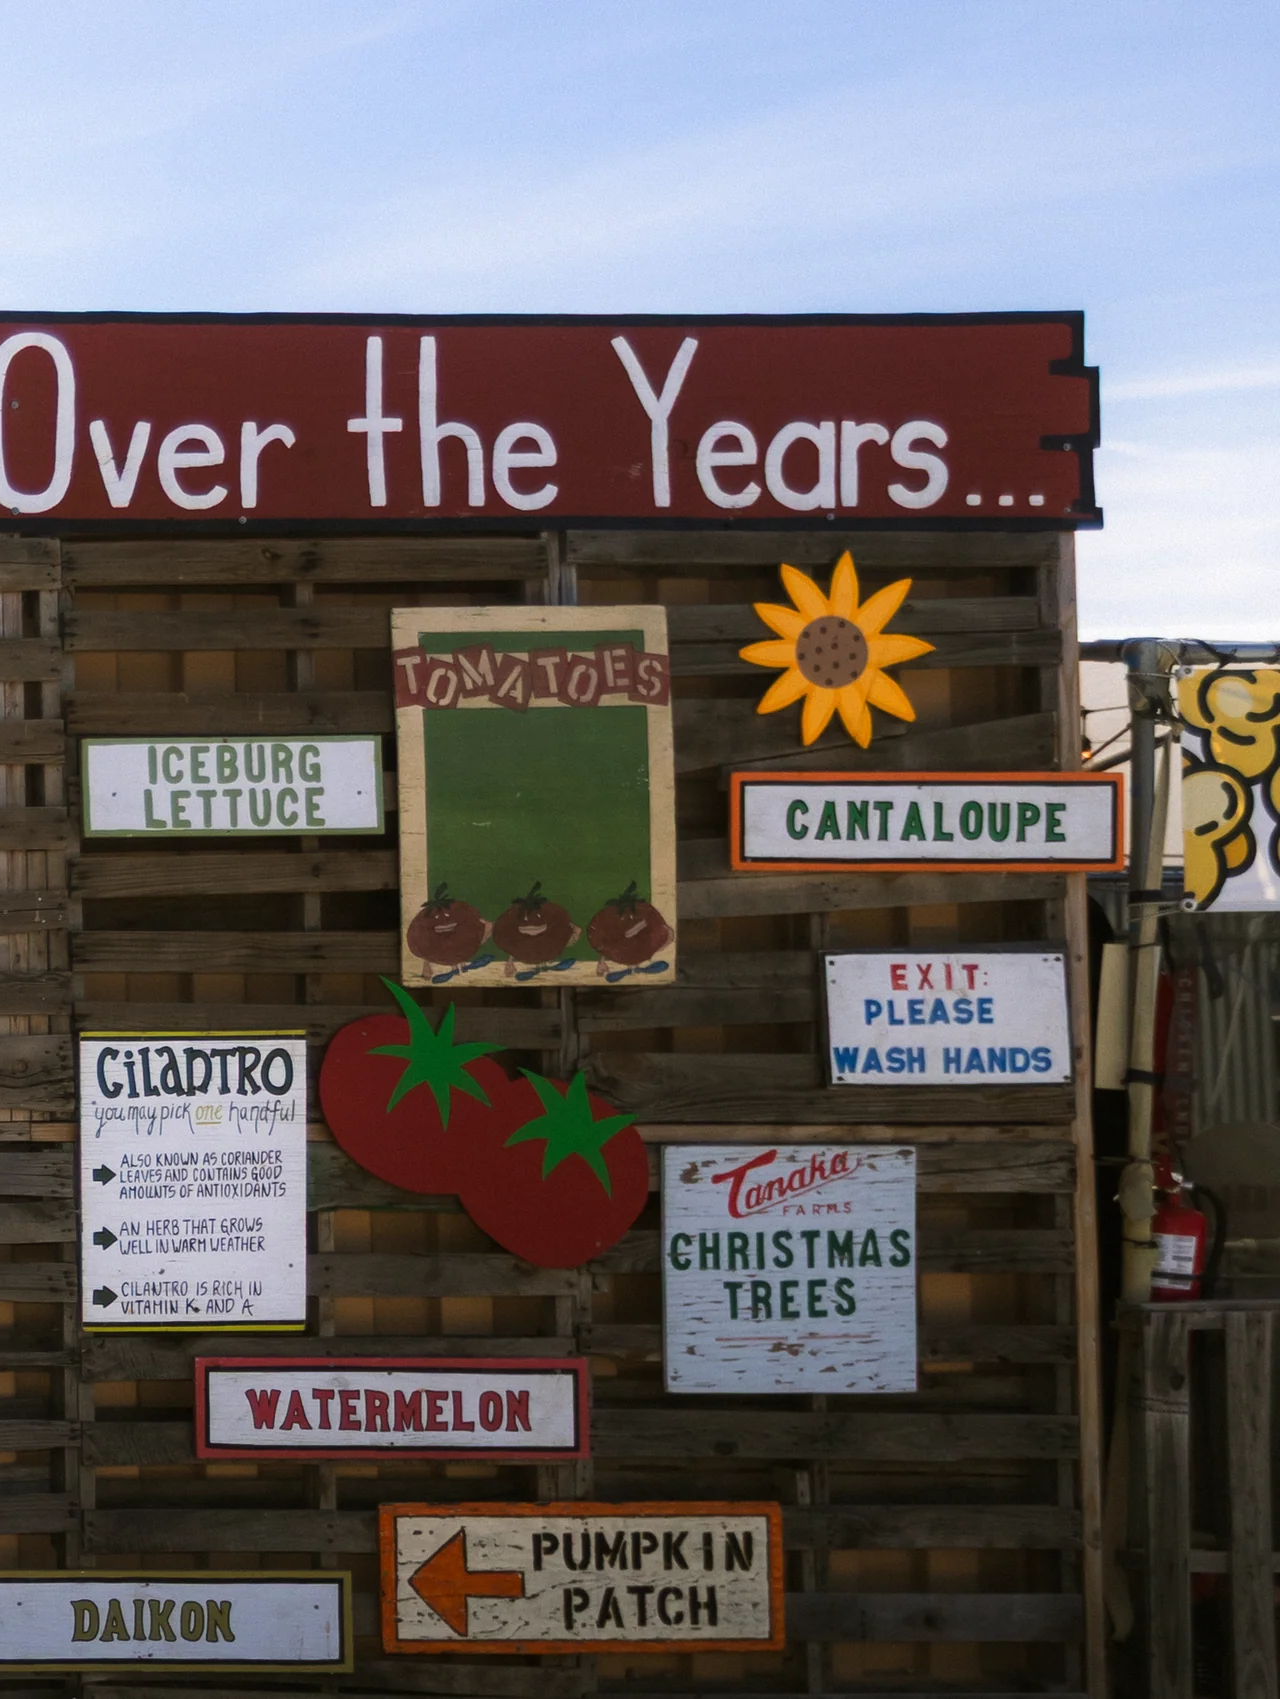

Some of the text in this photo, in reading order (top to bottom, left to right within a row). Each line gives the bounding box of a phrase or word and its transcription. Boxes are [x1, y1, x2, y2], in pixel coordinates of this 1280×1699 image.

[347, 335, 558, 511] the
[611, 336, 1044, 510] Years...
[397, 649, 663, 706] TOMATOES
[148, 743, 322, 785] ICEBURG
[143, 786, 325, 829] LETTUCE
[786, 799, 1066, 842] CANTALOUPE
[890, 963, 988, 991] EXIT:
[864, 998, 994, 1025] PLEASE
[834, 1047, 1052, 1074] WASH HANDS
[95, 1099, 295, 1138] you may pick one handful
[120, 1150, 283, 1167] ALSO KNOWN AS CORIANDER
[120, 1165, 283, 1183] LEAVES AND CONTAINS GOOD
[120, 1182, 286, 1199] AMOUNTS OF ANTIOXIDANTS
[711, 1149, 862, 1219] Tanaka
[120, 1217, 263, 1236] AN HERB THAT GROWS
[783, 1202, 852, 1216] FARMS
[119, 1236, 265, 1255] WELL IN WARM WEATHER
[669, 1228, 911, 1271] CHRISTMAS
[121, 1280, 262, 1298] CILANTRO IS RICH IN
[121, 1300, 178, 1315] VITAMIN
[206, 1299, 235, 1314] AND
[242, 1299, 254, 1316] A
[723, 1277, 856, 1320] TREES
[245, 1388, 532, 1433] WATERMELON
[532, 1530, 754, 1571] PUMPKIN
[71, 1599, 235, 1642] DAIKON
[563, 1585, 718, 1630] PATCH
